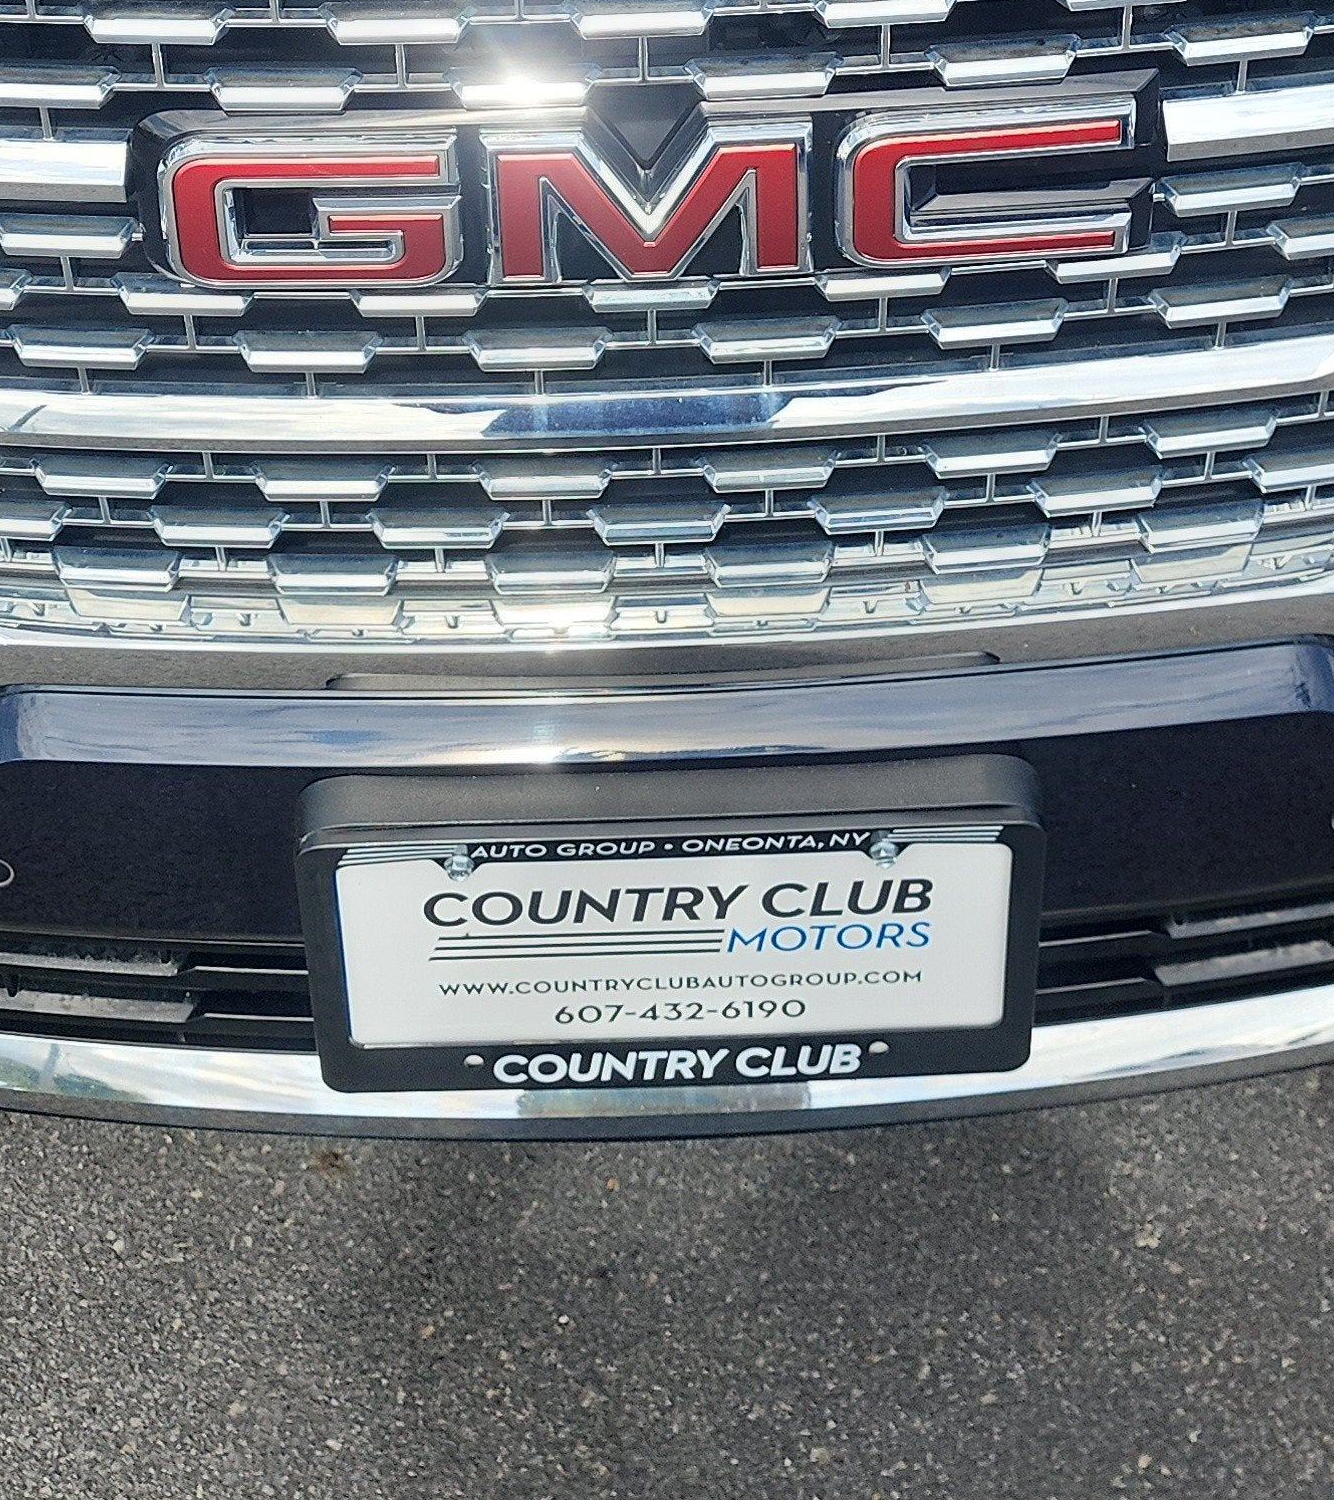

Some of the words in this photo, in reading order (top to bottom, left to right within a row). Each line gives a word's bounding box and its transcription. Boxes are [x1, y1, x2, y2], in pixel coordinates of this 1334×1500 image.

[159, 98, 1135, 287] GMC
[470, 843, 548, 858] AUTO
[556, 841, 655, 857] GROUP
[829, 831, 871, 847] NY
[423, 884, 749, 926] COUNTRY
[761, 879, 934, 917] CLUB
[727, 921, 932, 953] MOTORS
[439, 970, 922, 996] WWW.COUNTRYCLUBAUTOGROUP.COM
[554, 999, 806, 1024] 607-432-6190
[492, 1048, 730, 1084] COUNTRY
[735, 1043, 862, 1078] CLUB
